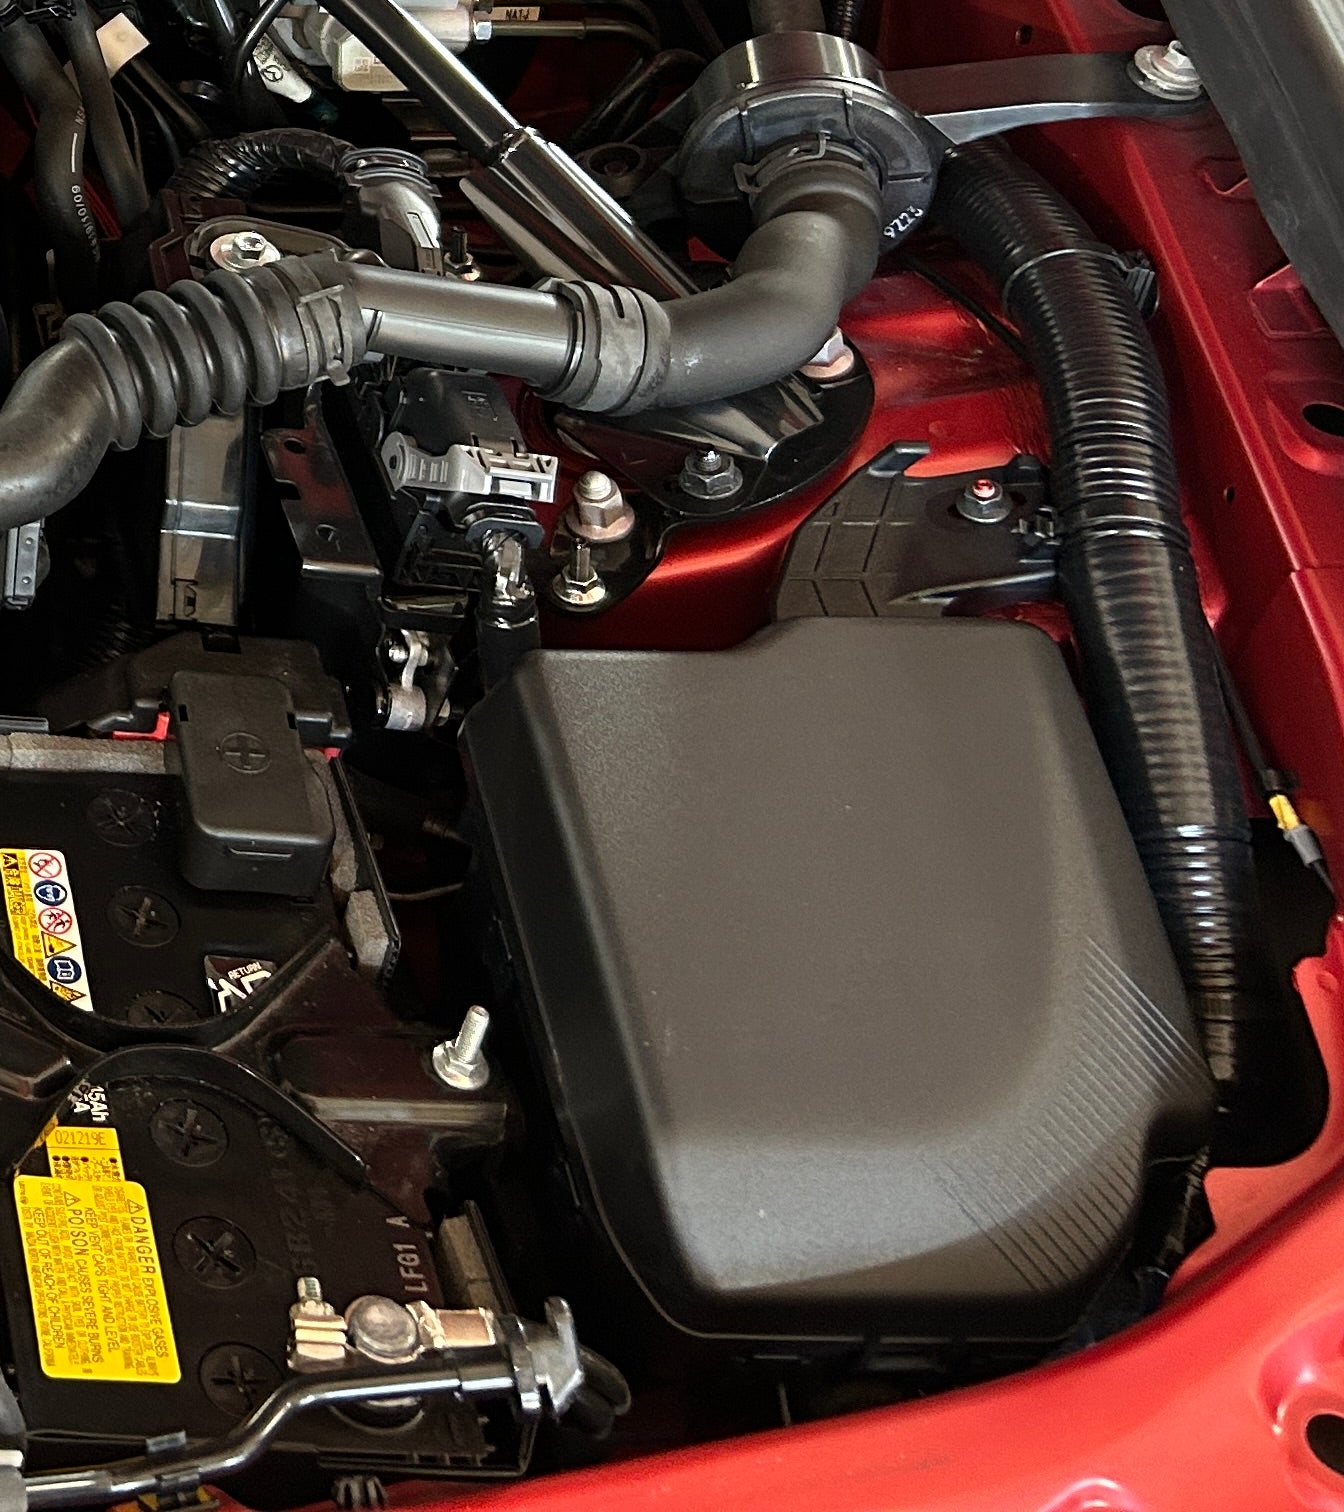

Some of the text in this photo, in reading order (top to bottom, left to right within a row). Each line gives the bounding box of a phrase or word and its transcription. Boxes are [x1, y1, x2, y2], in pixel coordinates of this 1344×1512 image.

[227, 961, 262, 980] RETURN
[55, 1130, 107, 1146] 021219E
[33, 1208, 46, 1227] KEEP
[84, 1208, 98, 1228] KEEP
[36, 1230, 49, 1246] OUT
[67, 1209, 89, 1255] POISON
[88, 1231, 102, 1251] VENT
[39, 1249, 52, 1260] OF
[131, 1217, 156, 1274] DANGER
[41, 1262, 56, 1290] REACH
[76, 1260, 92, 1293] CAUSES
[92, 1254, 108, 1277] CAPS
[46, 1292, 59, 1303] OF
[97, 1279, 112, 1303] TIGHT
[142, 1278, 162, 1326] EXPLOSIVE
[81, 1296, 99, 1330] SEVERE
[102, 1305, 115, 1323] AND
[48, 1306, 65, 1349] CHILDREN
[104, 1326, 120, 1352] LEVEL
[88, 1332, 104, 1363] BURNS
[152, 1327, 168, 1358] GASES
